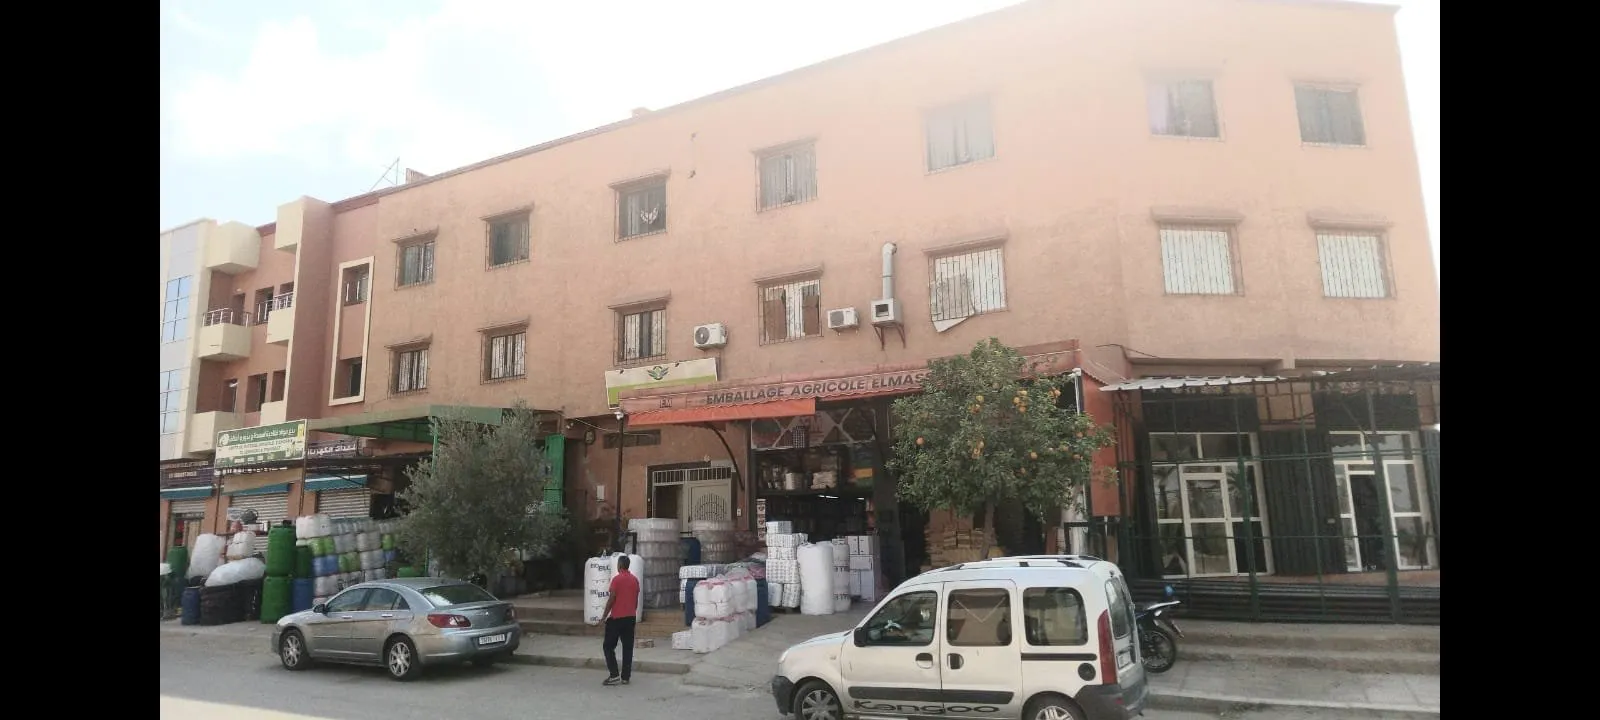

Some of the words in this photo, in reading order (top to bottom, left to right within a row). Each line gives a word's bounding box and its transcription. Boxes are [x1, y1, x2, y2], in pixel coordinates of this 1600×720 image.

[706, 386, 785, 405] EMBALLAGE
[791, 379, 865, 396] AGRICOLE
[854, 701, 999, 714] Kangoo
